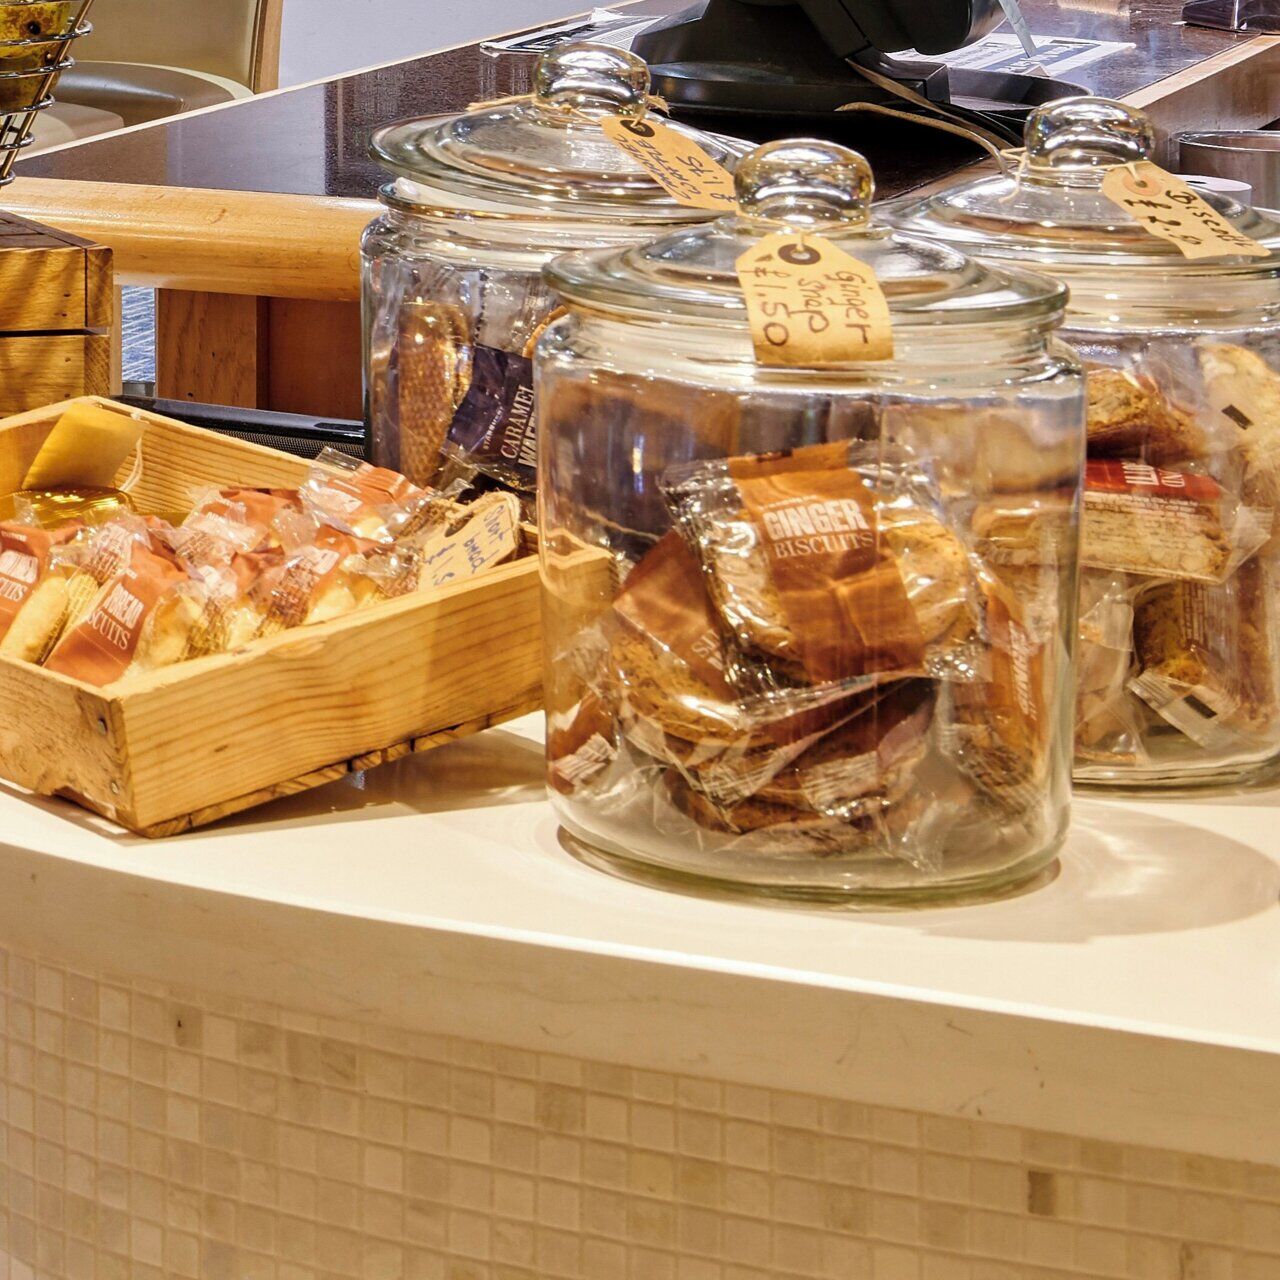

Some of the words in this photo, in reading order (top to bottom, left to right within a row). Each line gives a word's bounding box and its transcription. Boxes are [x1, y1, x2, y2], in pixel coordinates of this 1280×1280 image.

[739, 266, 791, 346] £1.50
[824, 270, 873, 344] Ginger
[762, 498, 870, 541] GINGER
[775, 532, 874, 559] BISCUITS
